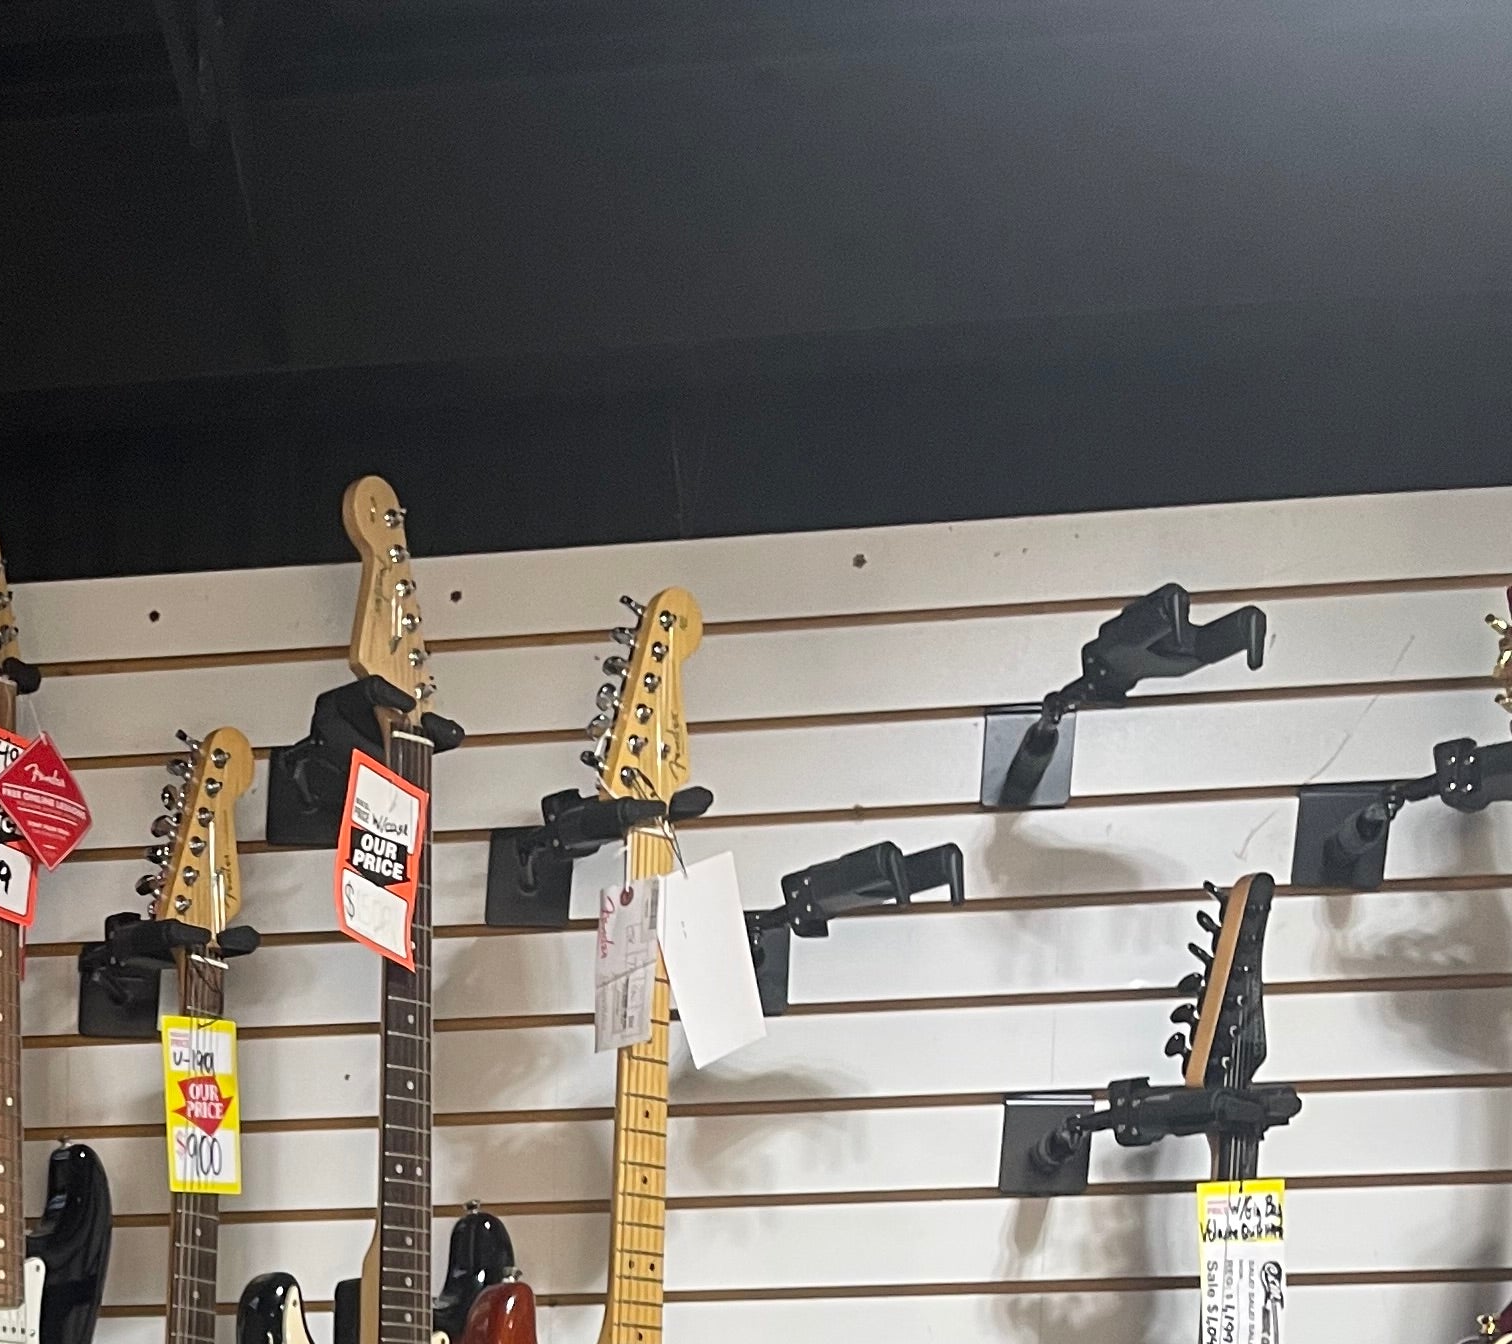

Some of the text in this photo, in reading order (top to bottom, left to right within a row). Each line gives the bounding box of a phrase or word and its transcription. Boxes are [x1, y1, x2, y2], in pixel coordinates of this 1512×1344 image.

[360, 833, 398, 861] OUR
[352, 847, 405, 881] PRICE
[188, 1083, 220, 1102] OUR
[185, 1100, 225, 1120] PRICE
[1206, 1260, 1219, 1298] Sale
